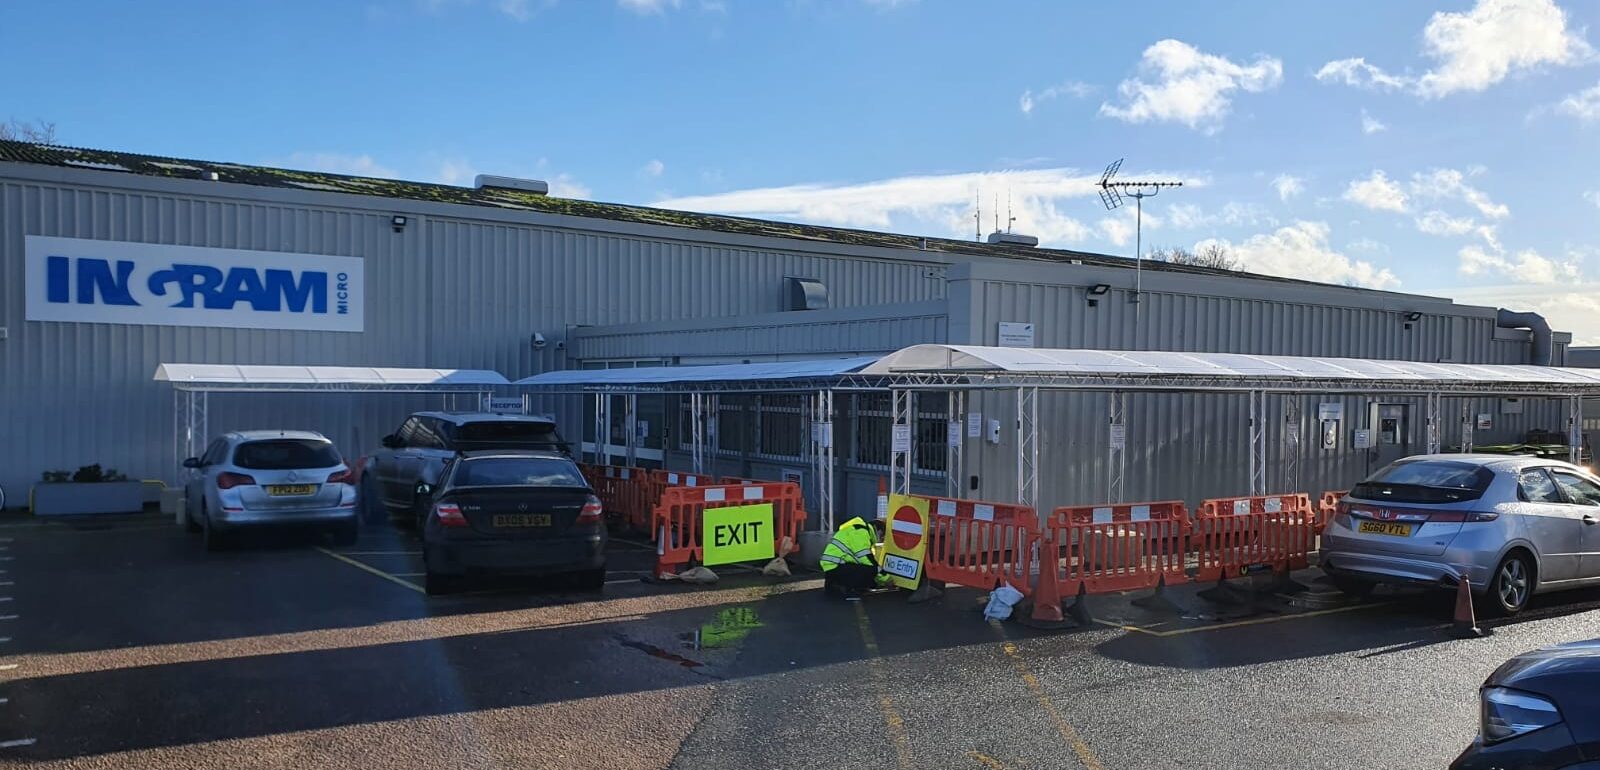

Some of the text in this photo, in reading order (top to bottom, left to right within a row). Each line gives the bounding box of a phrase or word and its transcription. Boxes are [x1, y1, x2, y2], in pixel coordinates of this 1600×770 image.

[47, 256, 328, 314] INGRAM
[337, 272, 348, 314] MICRO
[714, 521, 763, 547] EXIT
[1361, 522, 1406, 535] SG60 VTL
[885, 557, 915, 576] No Entry
